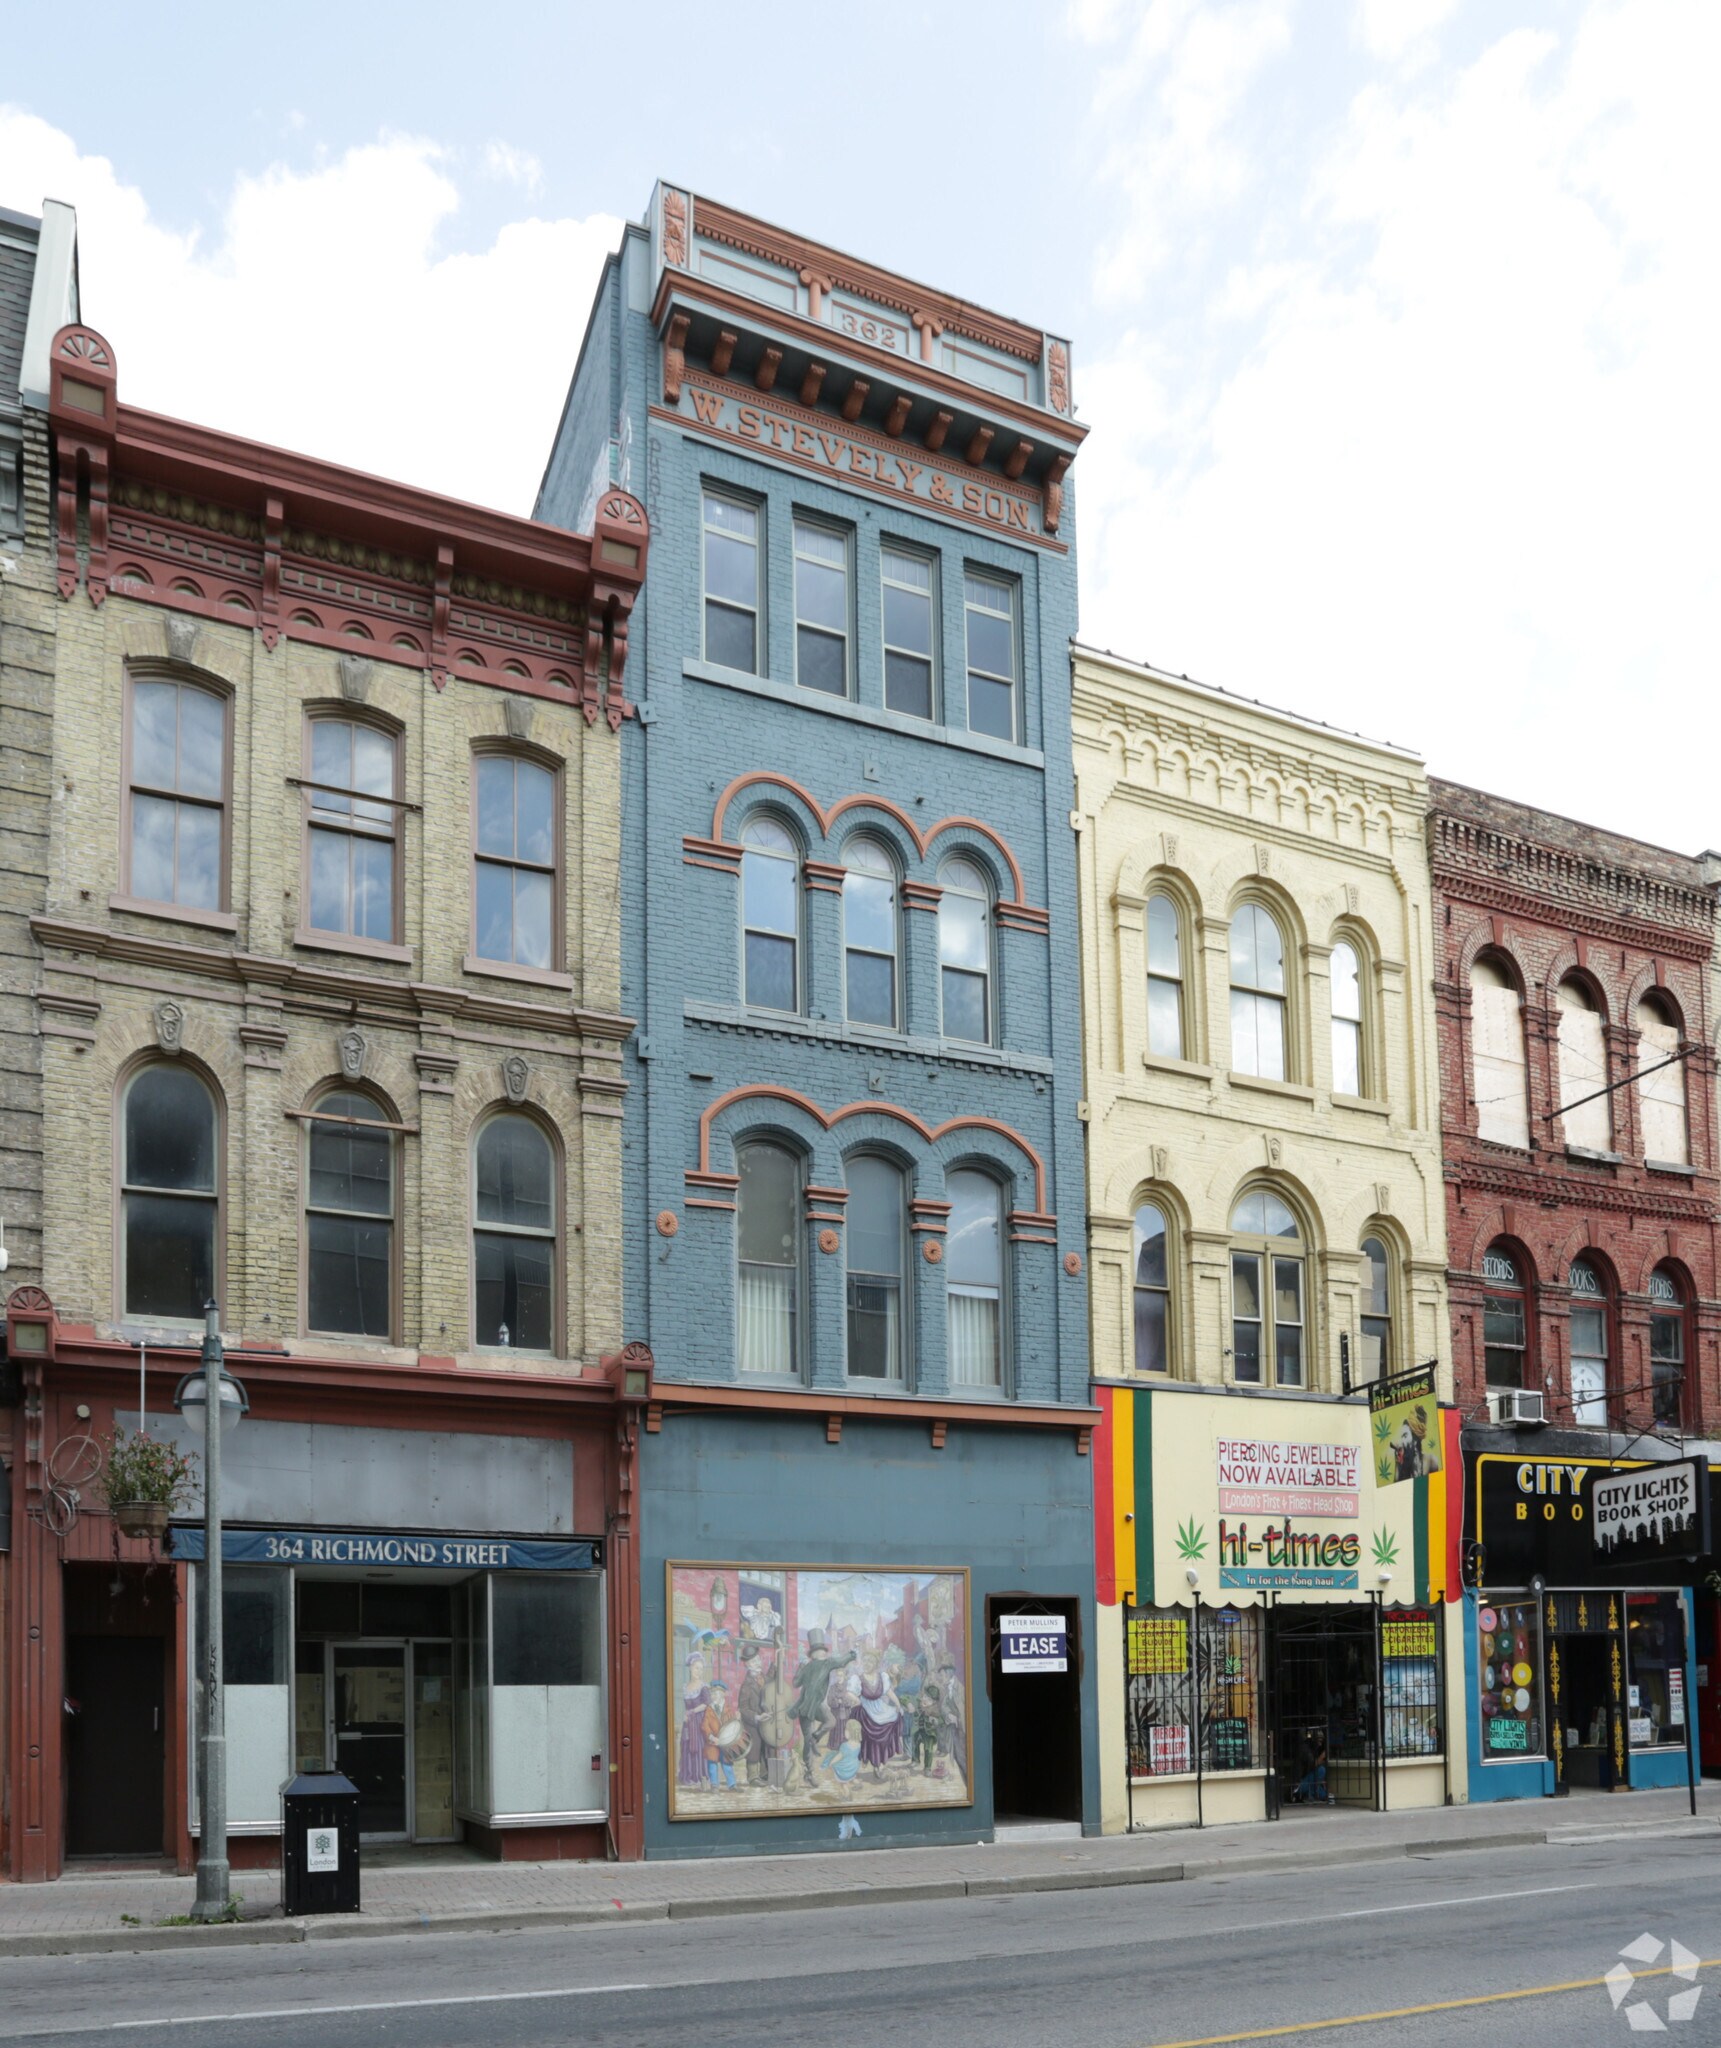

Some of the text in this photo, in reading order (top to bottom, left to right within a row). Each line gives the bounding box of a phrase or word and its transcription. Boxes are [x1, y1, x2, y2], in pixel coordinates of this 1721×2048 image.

[842, 314, 896, 349] 362
[689, 387, 1037, 533] W. STEVELY & SON.
[1372, 1378, 1430, 1411] hi-times
[1218, 1441, 1358, 1467] PIERCING JEWELLERY
[1219, 1464, 1357, 1486] NOW AVAILABLE
[1516, 1463, 1588, 1495] CITY
[1225, 1492, 1261, 1509] London's
[1262, 1494, 1281, 1510] First
[1288, 1494, 1311, 1511] Finest
[1313, 1497, 1333, 1512] Head
[1334, 1497, 1353, 1514] Shop
[1598, 1474, 1689, 1507] CITY LIGHTS
[1598, 1496, 1690, 1523] BOOK SHOP
[265, 1537, 511, 1565] 364 RICHMOND STREET
[1219, 1518, 1361, 1567] hi-times
[1246, 1574, 1256, 1585] in
[1258, 1575, 1271, 1585] for
[1274, 1575, 1289, 1586] the
[1315, 1576, 1334, 1586] haul
[1009, 1637, 1059, 1655] LEASE
[1153, 1727, 1186, 1740] PIERCING
[1153, 1742, 1187, 1756] JEWELLERY
[310, 1858, 336, 1866] London
